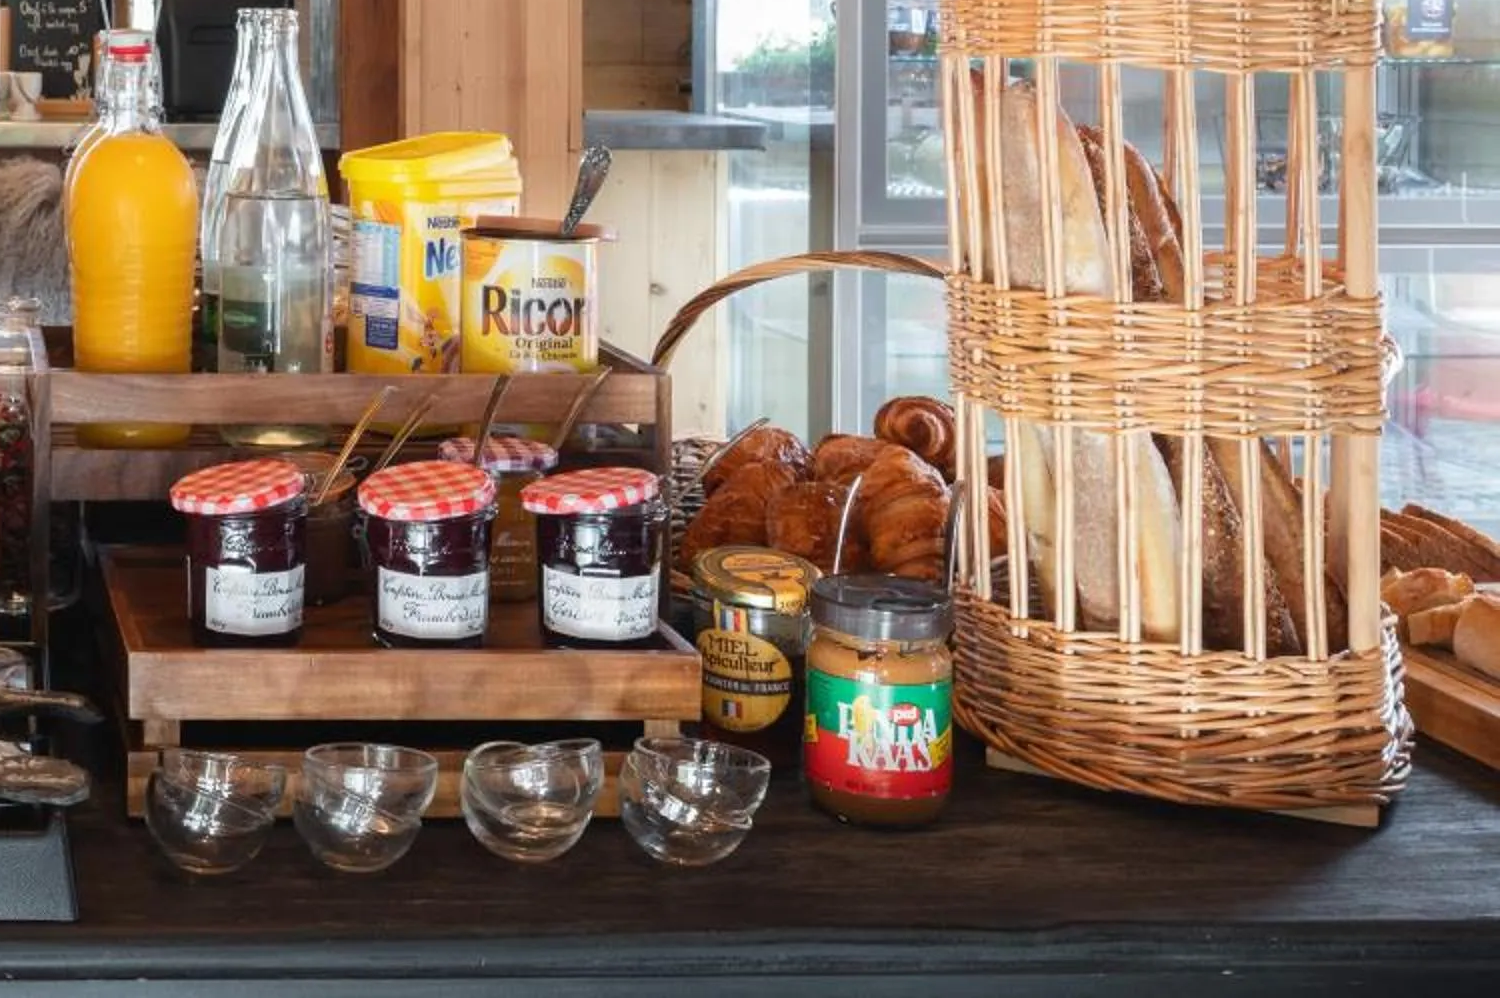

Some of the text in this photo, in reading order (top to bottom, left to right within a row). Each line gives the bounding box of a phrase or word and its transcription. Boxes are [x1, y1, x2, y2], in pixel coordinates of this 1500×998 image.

[481, 285, 586, 336] Ricor
[515, 337, 574, 352] Original
[708, 633, 759, 657] MIEL
